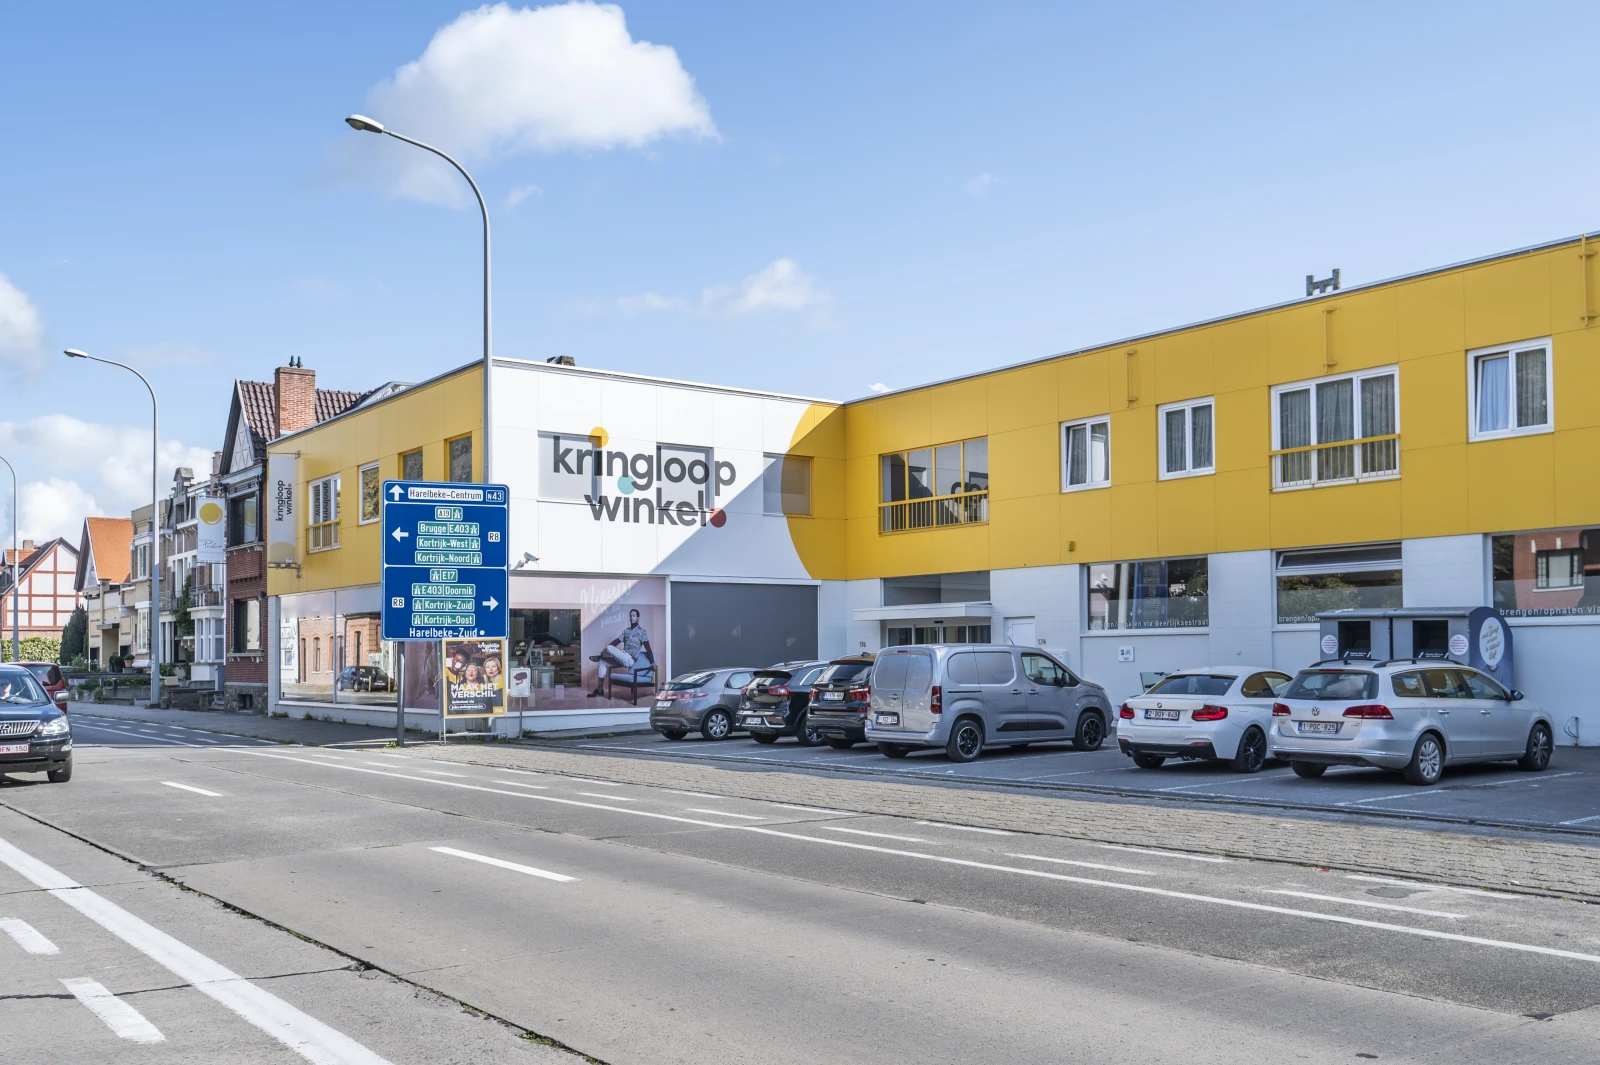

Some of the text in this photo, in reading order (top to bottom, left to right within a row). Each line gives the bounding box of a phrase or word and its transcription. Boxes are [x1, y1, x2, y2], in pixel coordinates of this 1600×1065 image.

[553, 427, 736, 496] kringloop
[409, 489, 482, 500] Harelbeke-Centrum
[487, 492, 503, 501] N43
[275, 480, 286, 522] kringloop
[420, 524, 470, 534] Brugge E403
[489, 533, 499, 541] R8
[419, 538, 469, 549] Kortrijk-West
[417, 553, 470, 564] Kortrijk-Noord
[442, 571, 456, 580] E17
[422, 586, 473, 595] E403 Doornik
[393, 598, 404, 607] R8
[424, 600, 472, 611] Kortrijk-Zuid
[1500, 607, 1583, 617] brengen/ophalen
[424, 615, 472, 625] Kortrijk-Oost
[1155, 619, 1208, 628] deerlijksestraat
[409, 628, 478, 638] Harelbeke-Zuid
[1037, 638, 1047, 646] 174
[451, 683, 499, 692] MAAK HET
